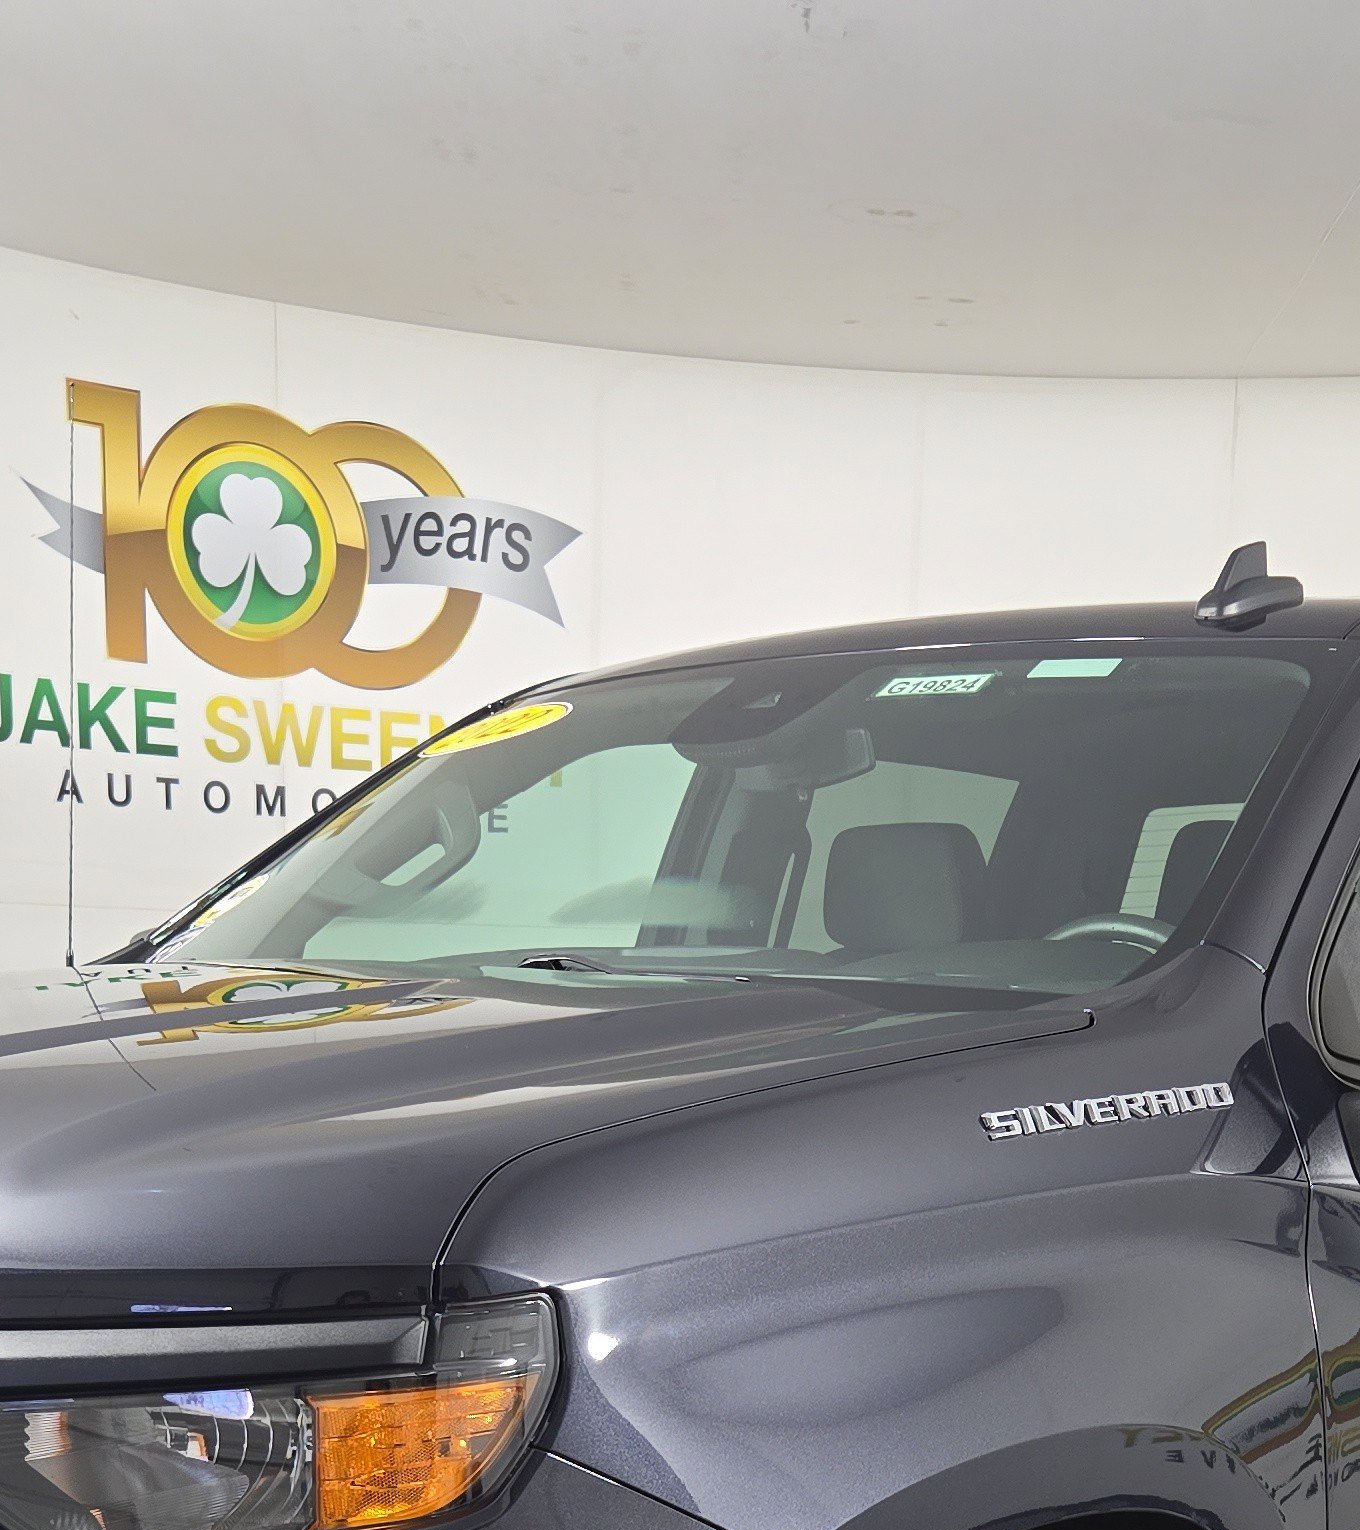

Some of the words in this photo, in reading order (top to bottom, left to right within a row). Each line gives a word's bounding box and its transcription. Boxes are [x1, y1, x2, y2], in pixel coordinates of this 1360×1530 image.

[379, 505, 532, 572] years
[887, 677, 981, 695] G19824
[203, 696, 448, 771] SWEE
[979, 1081, 1236, 1141] SILVERADO
